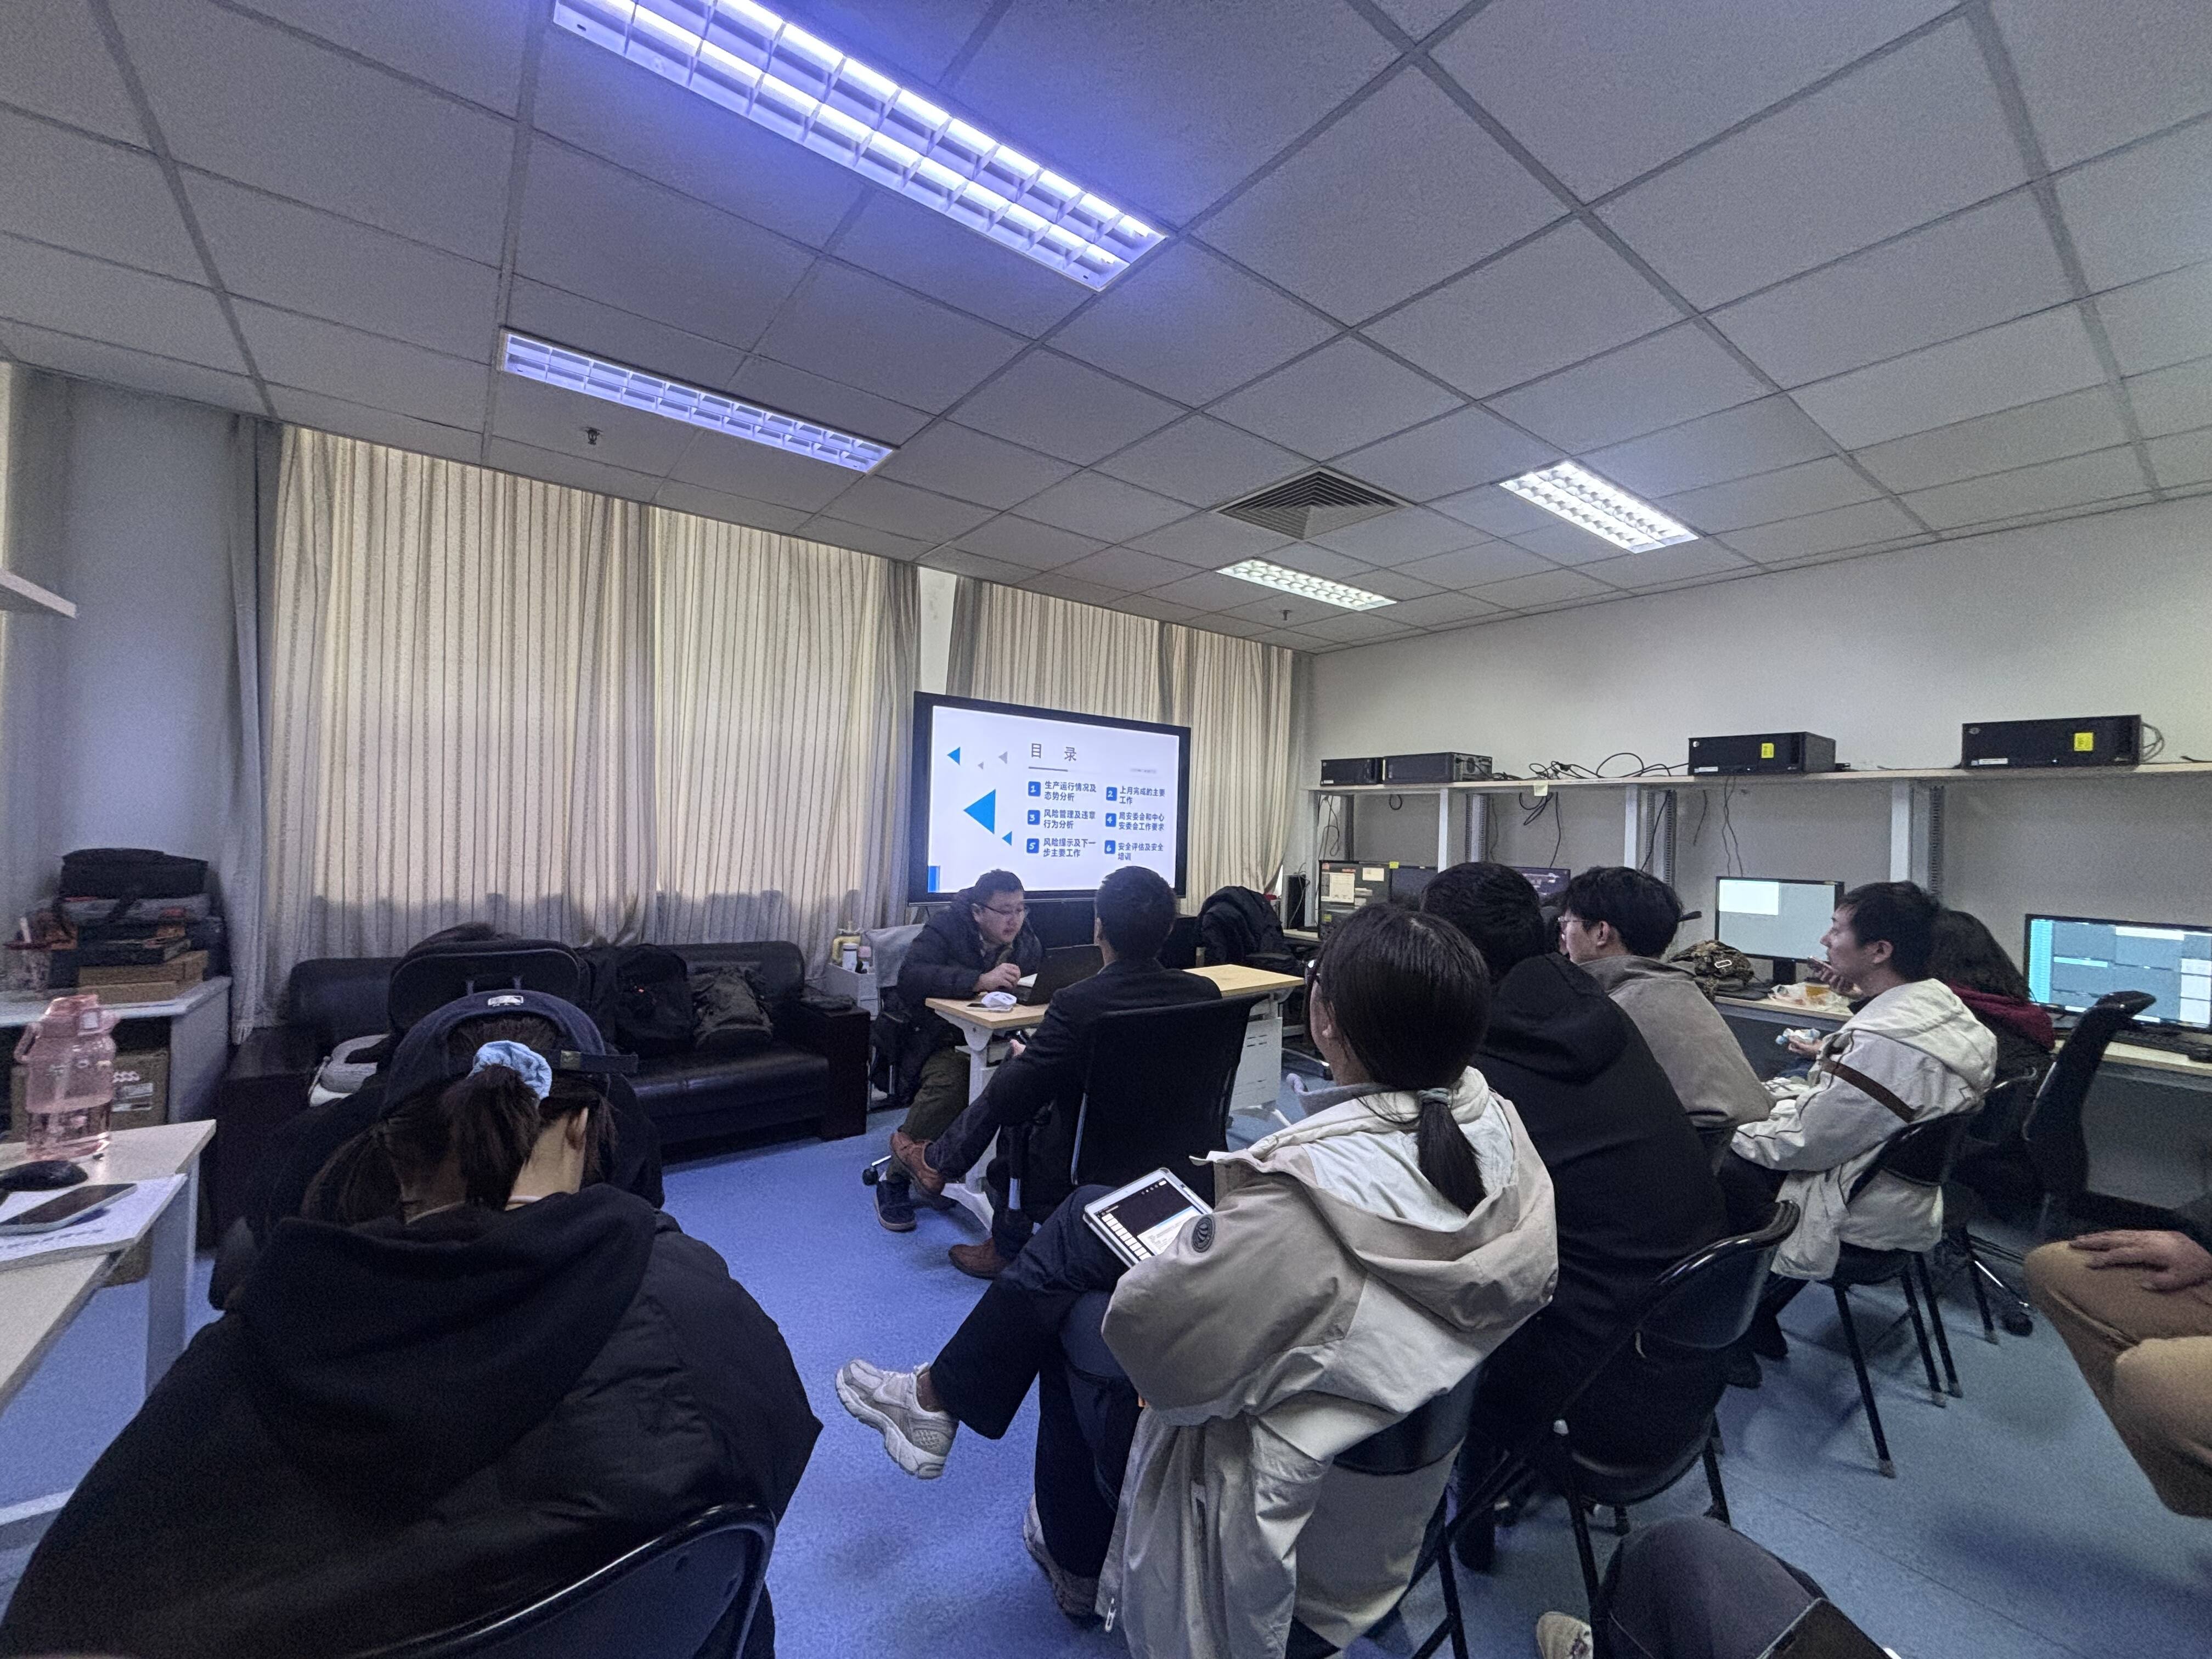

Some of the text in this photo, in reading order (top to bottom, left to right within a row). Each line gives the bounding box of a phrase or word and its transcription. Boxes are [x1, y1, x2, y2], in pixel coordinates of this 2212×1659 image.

[1045, 780, 1097, 793] 生产运行情况及
[1120, 786, 1165, 797] 上月完成的主要
[1044, 791, 1075, 802] 态势分析
[1119, 796, 1133, 805] 工作
[1043, 820, 1074, 829] 行为分析
[1119, 822, 1164, 831] 安委会工作要求
[1043, 838, 1097, 848] 风险提示及下一
[1118, 843, 1164, 851] 安全评估及安全
[1043, 848, 1081, 857] 步主要工作
[1118, 853, 1131, 861] 培训
